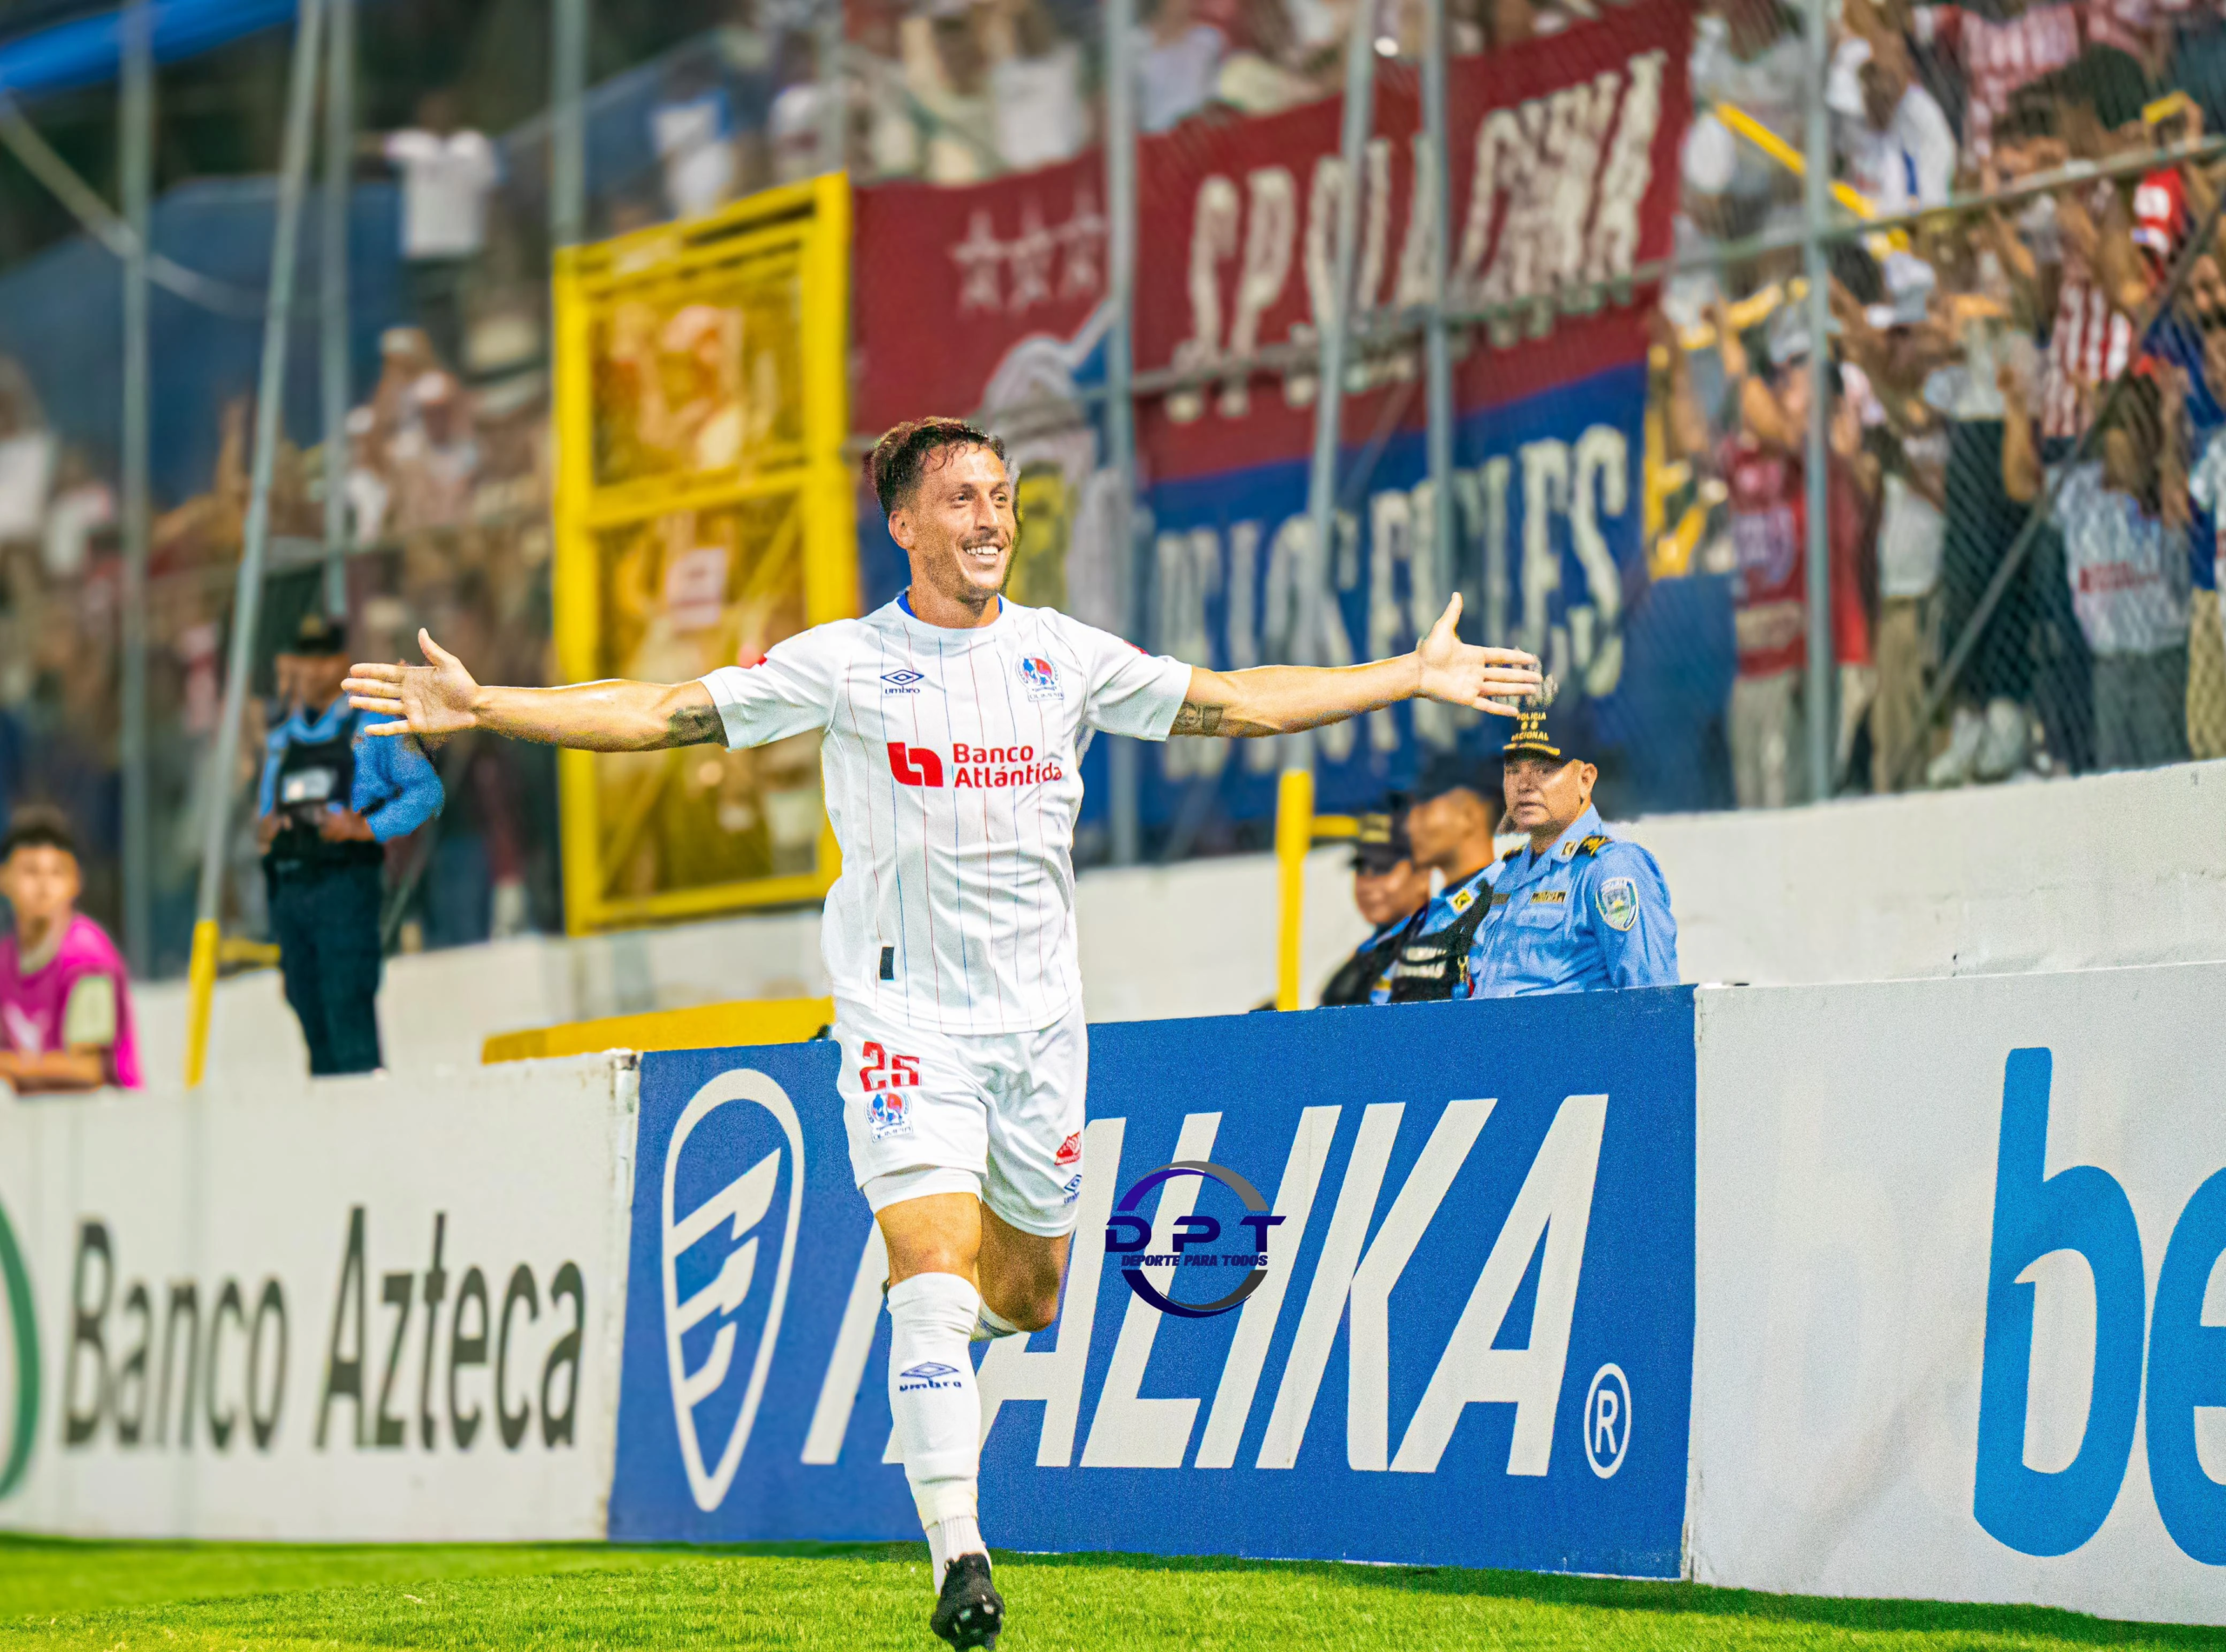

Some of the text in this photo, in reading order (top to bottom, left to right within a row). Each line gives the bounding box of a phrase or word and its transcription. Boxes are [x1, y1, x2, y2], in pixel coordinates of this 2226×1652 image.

[884, 685, 921, 695] umbro
[953, 743, 1034, 763] Banco
[954, 762, 1063, 789] Atlántida
[859, 1041, 921, 1092] 25
[59, 1203, 587, 1455] Banco Azteca
[899, 1377, 963, 1392] umbro
